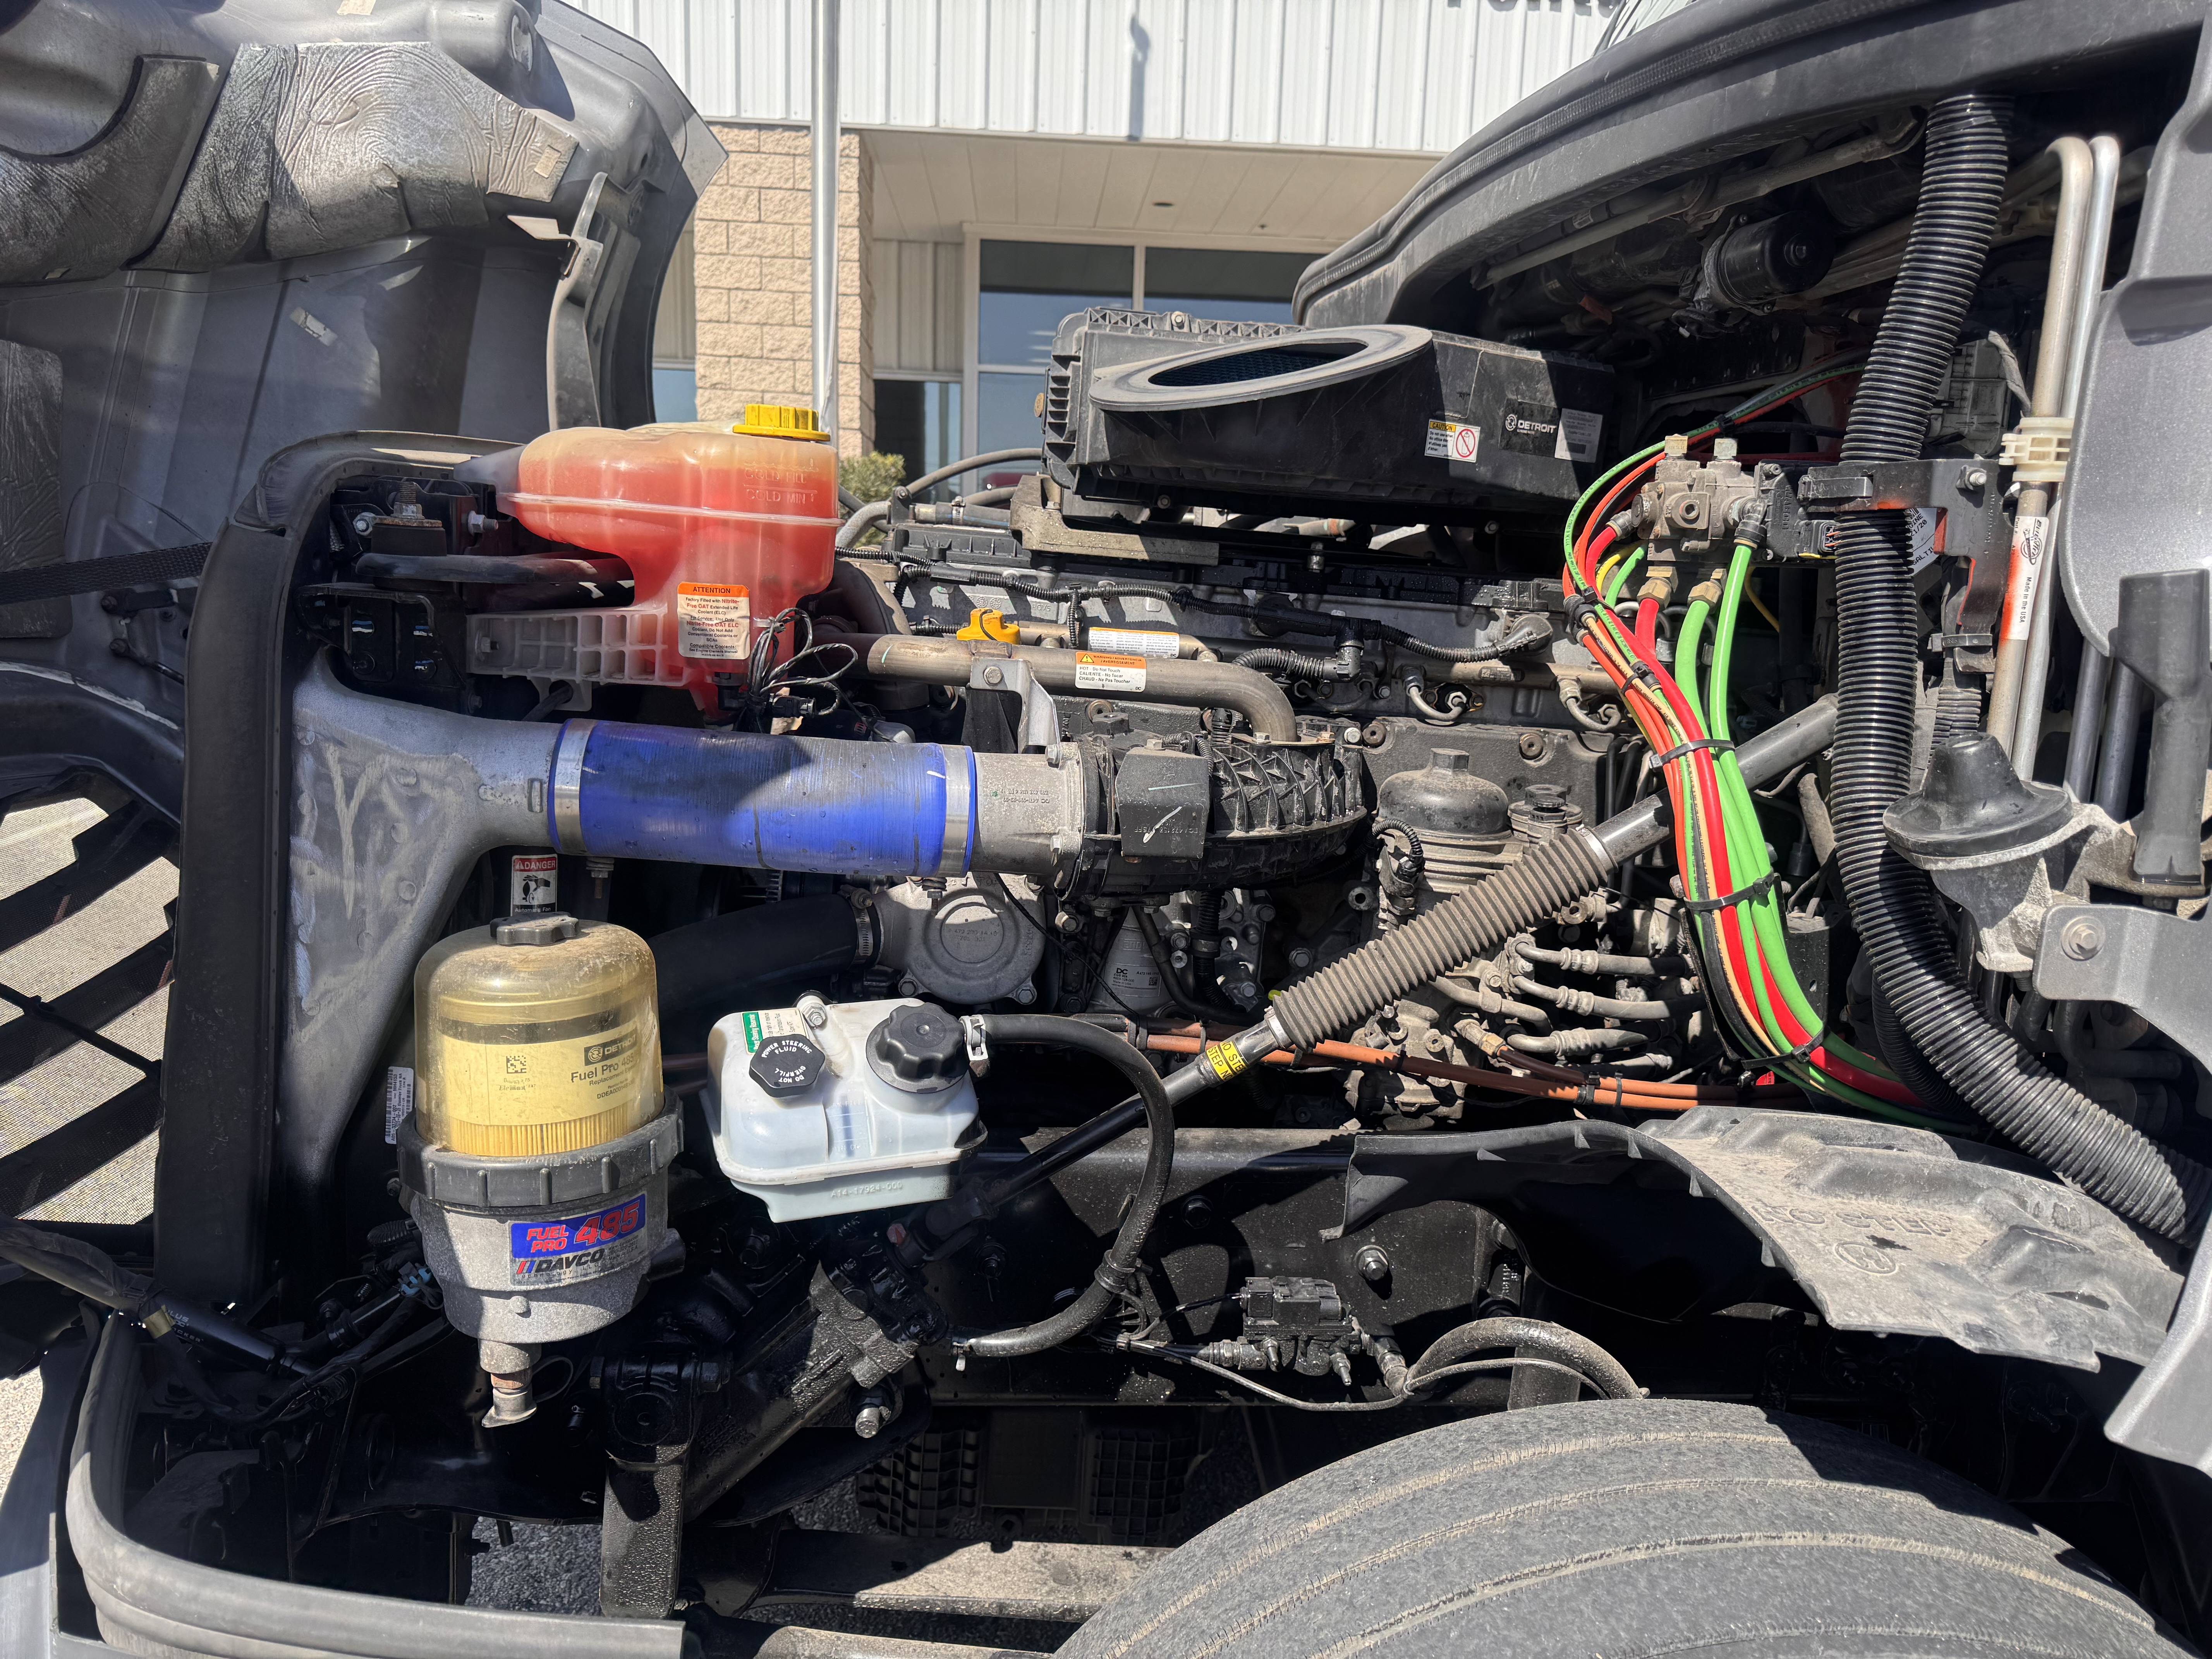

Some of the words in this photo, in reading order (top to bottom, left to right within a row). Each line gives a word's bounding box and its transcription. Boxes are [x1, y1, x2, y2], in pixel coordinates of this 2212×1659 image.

[1518, 420, 1557, 433] DETROIT
[745, 468, 780, 481] COLD
[747, 489, 781, 501] COLD
[787, 493, 805, 504] MIN
[2024, 577, 2032, 592] Made
[525, 860, 555, 869] DANGER
[748, 1014, 757, 1028] Reservoir
[750, 1028, 759, 1040] Steering
[605, 1034, 635, 1055] DETROIT
[762, 1043, 778, 1058] POWER
[782, 1041, 812, 1054] STEERING
[775, 1046, 797, 1054] FLUID
[1207, 1046, 1223, 1067] STEP
[571, 1067, 597, 1082] Fuel
[601, 1063, 618, 1075] Pro
[589, 1070, 623, 1086] Replacement
[775, 1066, 806, 1077] OVERFILL
[831, 1182, 903, 1198] A14-17924-000
[527, 1225, 569, 1240] FUEL
[574, 1200, 640, 1246] 485
[1751, 1206, 1825, 1224] NO
[1836, 1211, 1951, 1237] STEP
[531, 1238, 567, 1252] PRO
[535, 1248, 605, 1273] DAVCO
[582, 1262, 599, 1270] LLC
